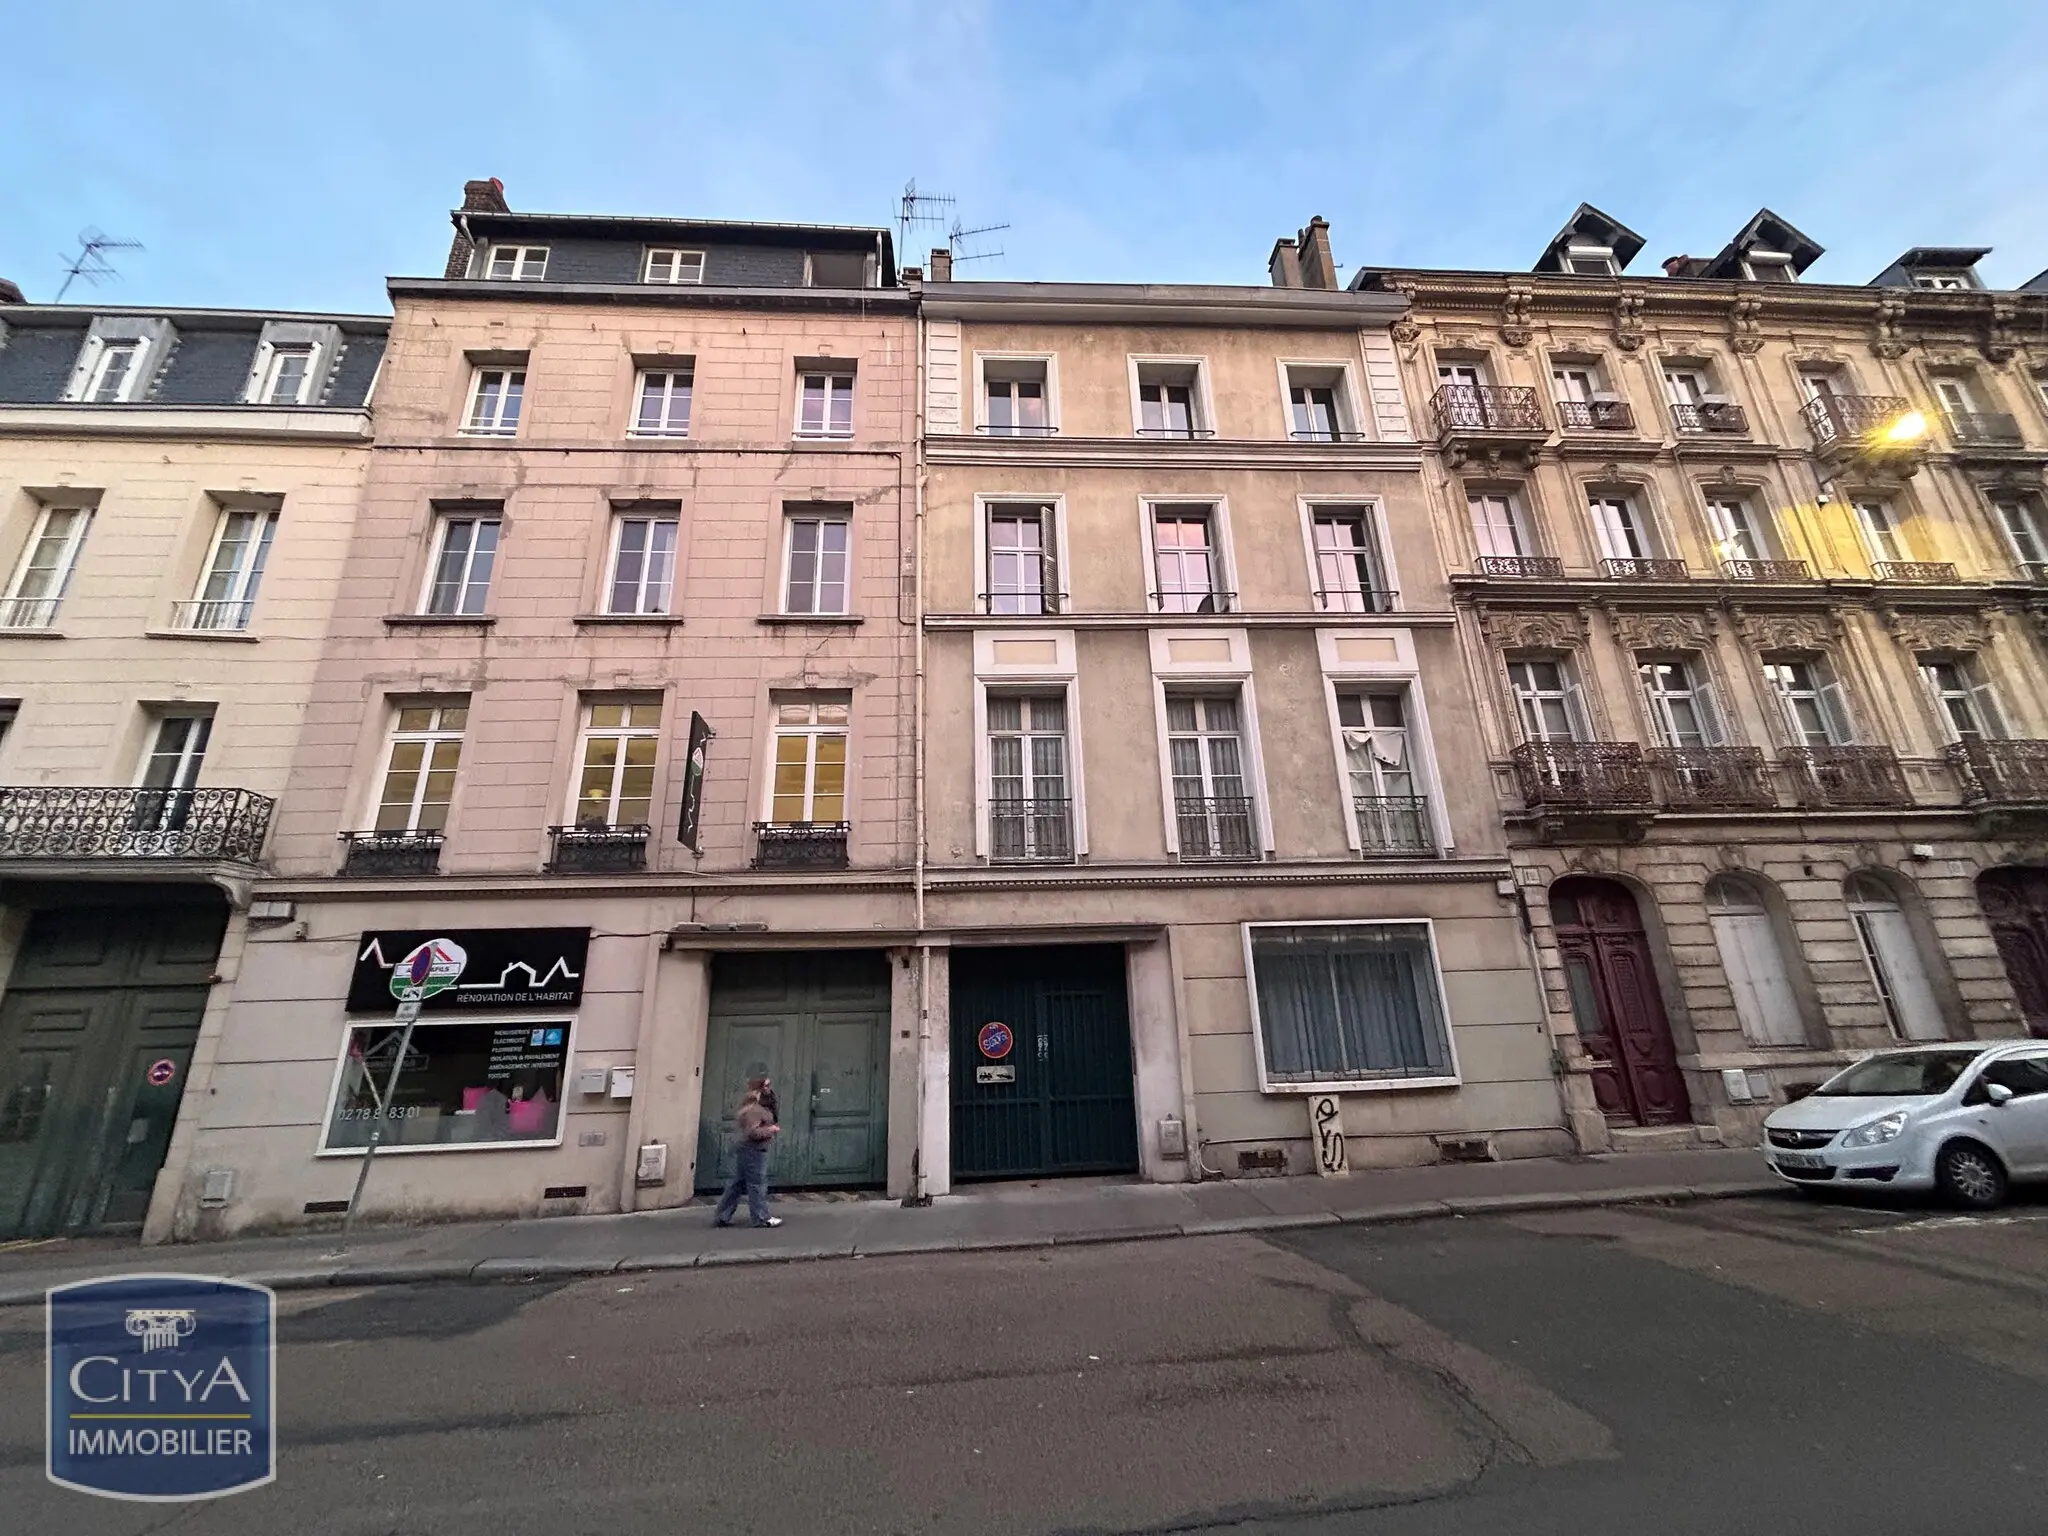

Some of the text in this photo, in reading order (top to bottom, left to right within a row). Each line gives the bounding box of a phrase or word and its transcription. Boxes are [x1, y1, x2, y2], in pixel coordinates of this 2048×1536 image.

[456, 991, 574, 1003] RÉNOVATION DE L'HABITAT
